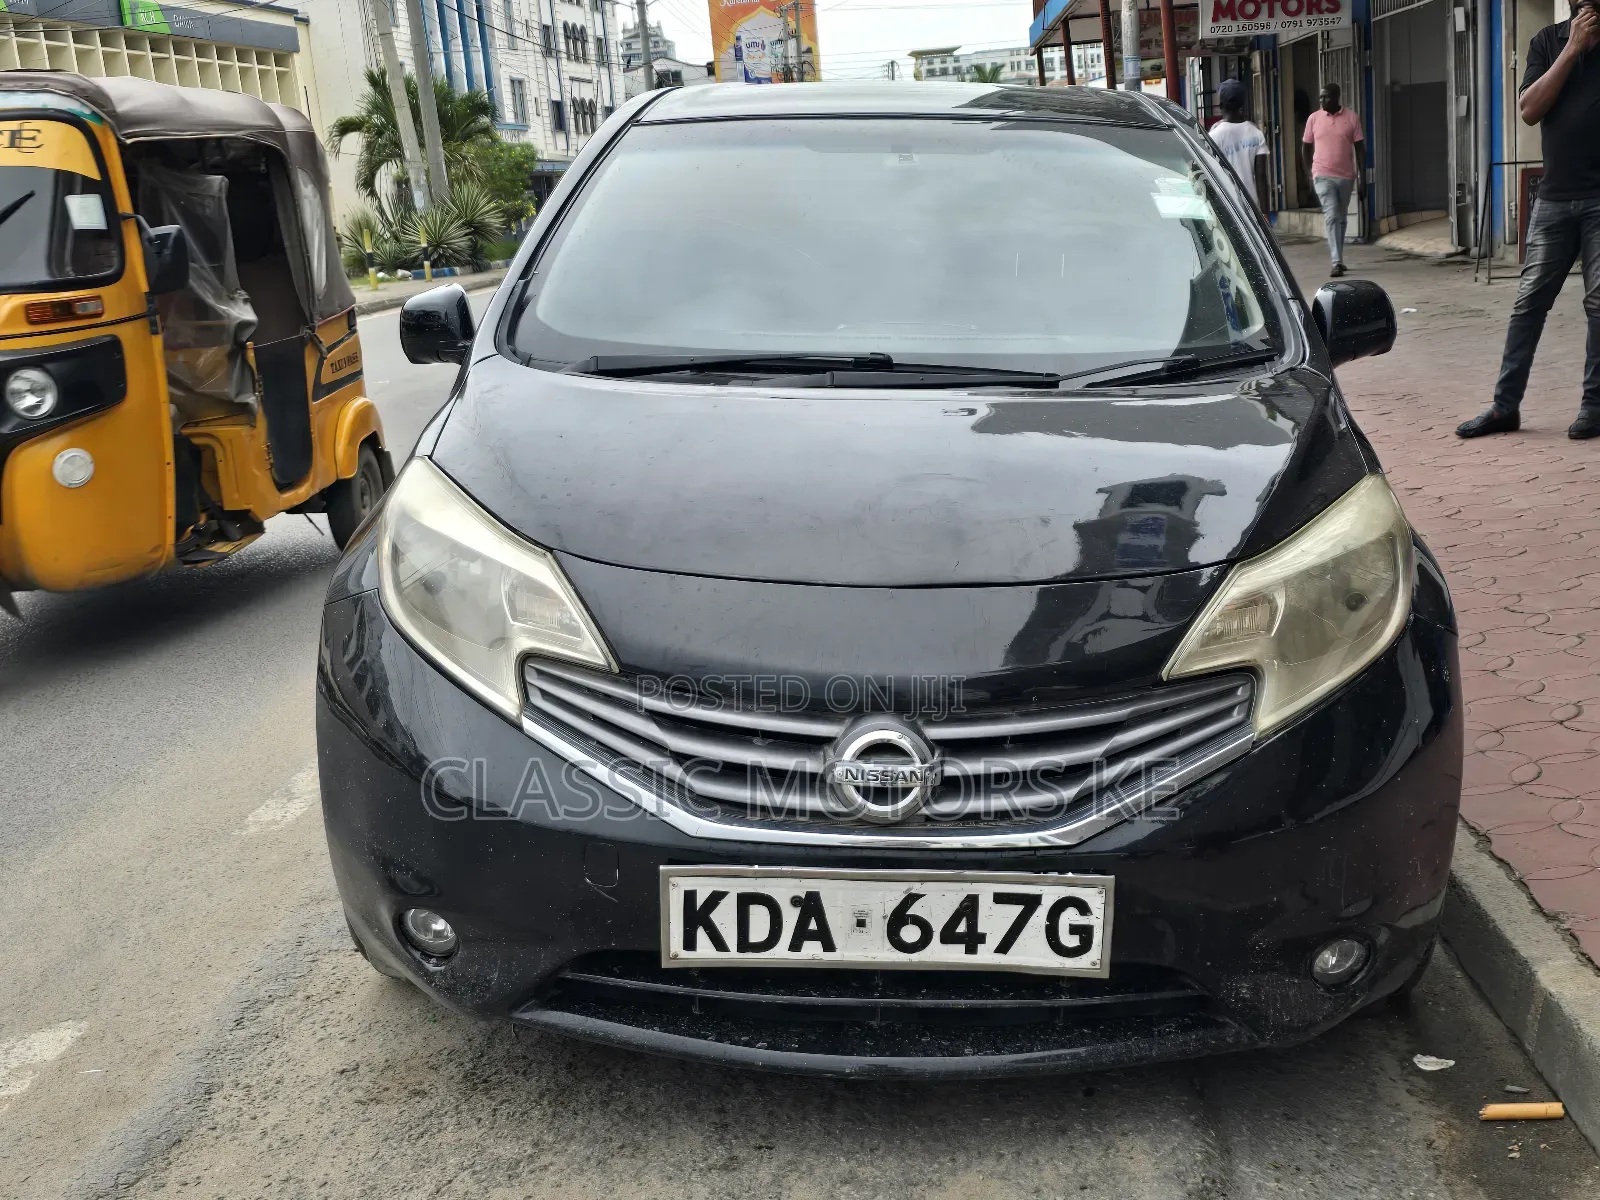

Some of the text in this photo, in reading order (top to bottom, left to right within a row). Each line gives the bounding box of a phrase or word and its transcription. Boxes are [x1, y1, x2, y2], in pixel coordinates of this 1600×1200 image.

[1211, 0, 1342, 23] MOTORS
[1210, 25, 1233, 34] 0720
[1280, 20, 1304, 29] 0791
[843, 767, 925, 785] NISSAN
[682, 889, 837, 954] KDA
[885, 891, 1096, 959] 647G
